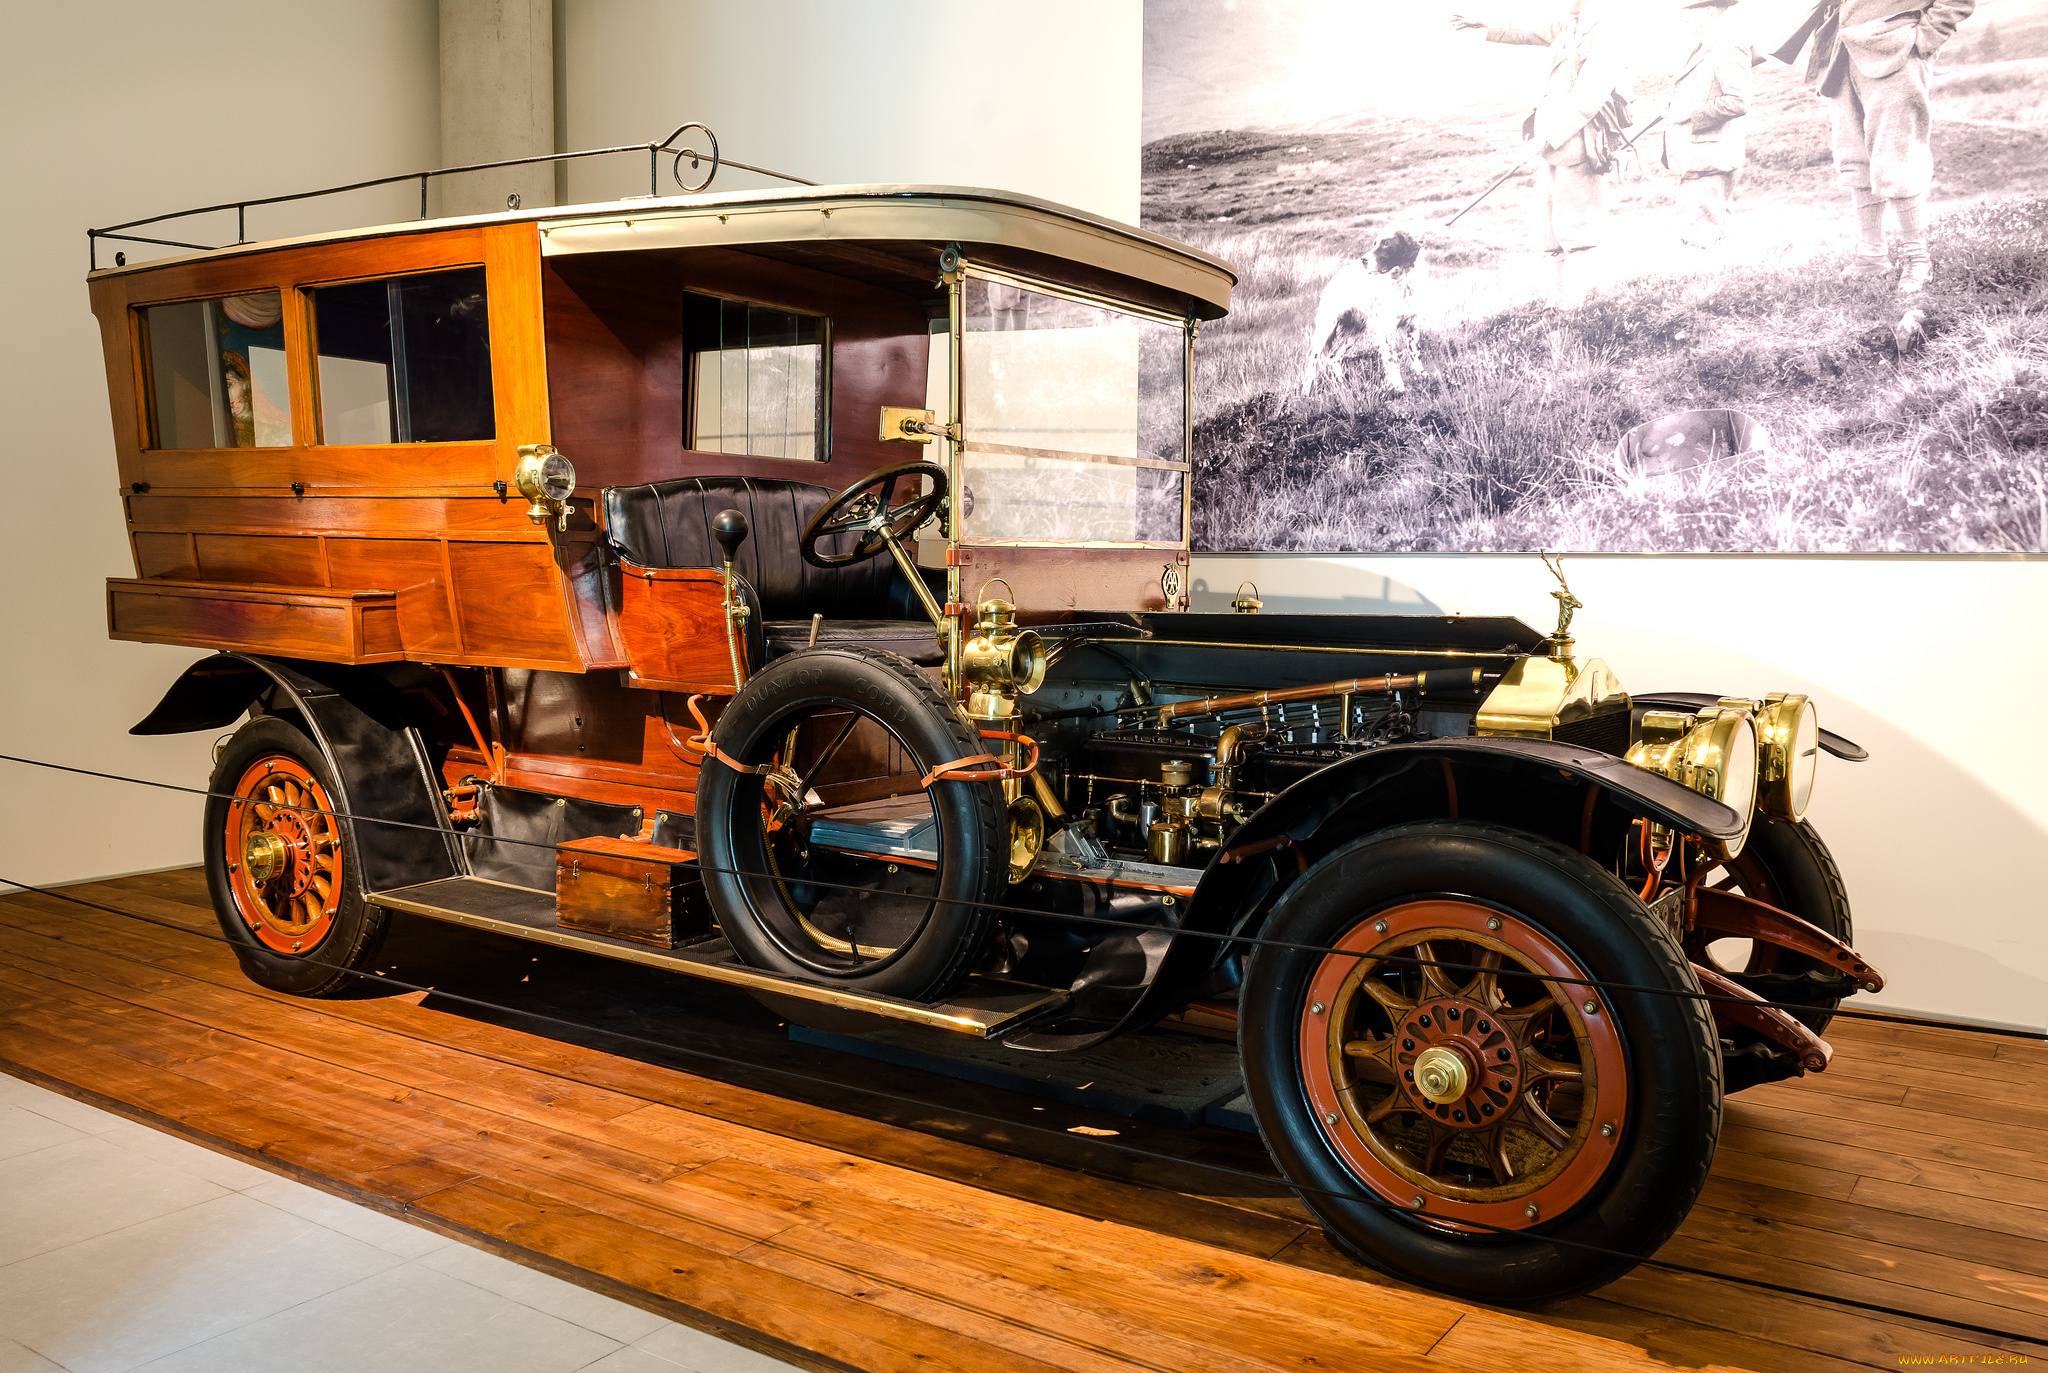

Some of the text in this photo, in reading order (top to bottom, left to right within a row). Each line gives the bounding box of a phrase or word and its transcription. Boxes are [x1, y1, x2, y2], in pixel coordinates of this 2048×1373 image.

[746, 668, 908, 723] DUNLOP CORD
[1621, 1086, 1676, 1222] DUNLOP
